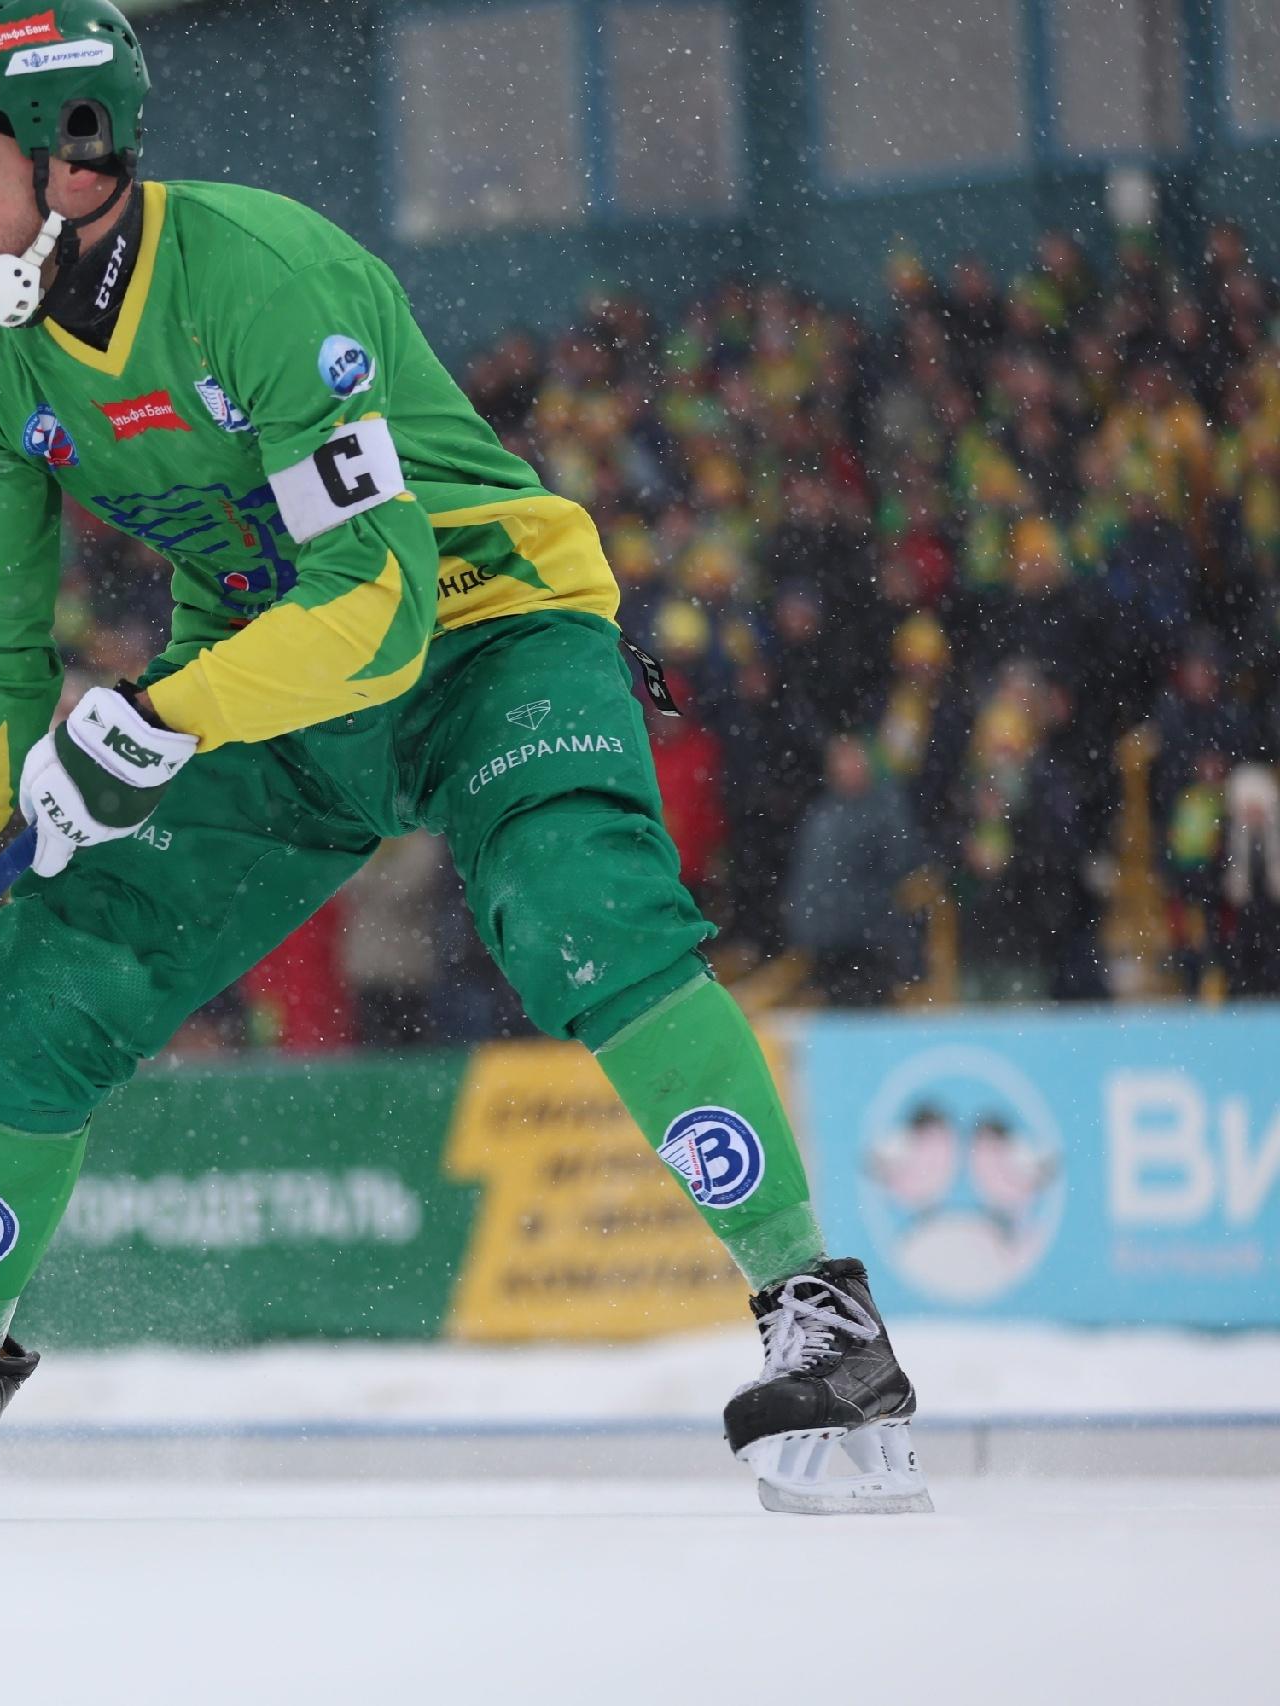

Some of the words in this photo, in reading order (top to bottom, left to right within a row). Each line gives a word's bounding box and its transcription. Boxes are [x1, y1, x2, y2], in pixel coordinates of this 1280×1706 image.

[95, 235, 127, 309] CCM
[313, 433, 381, 508] C
[469, 734, 624, 795] СЕВЕРАЛМАЗ
[40, 791, 91, 844] TEAM
